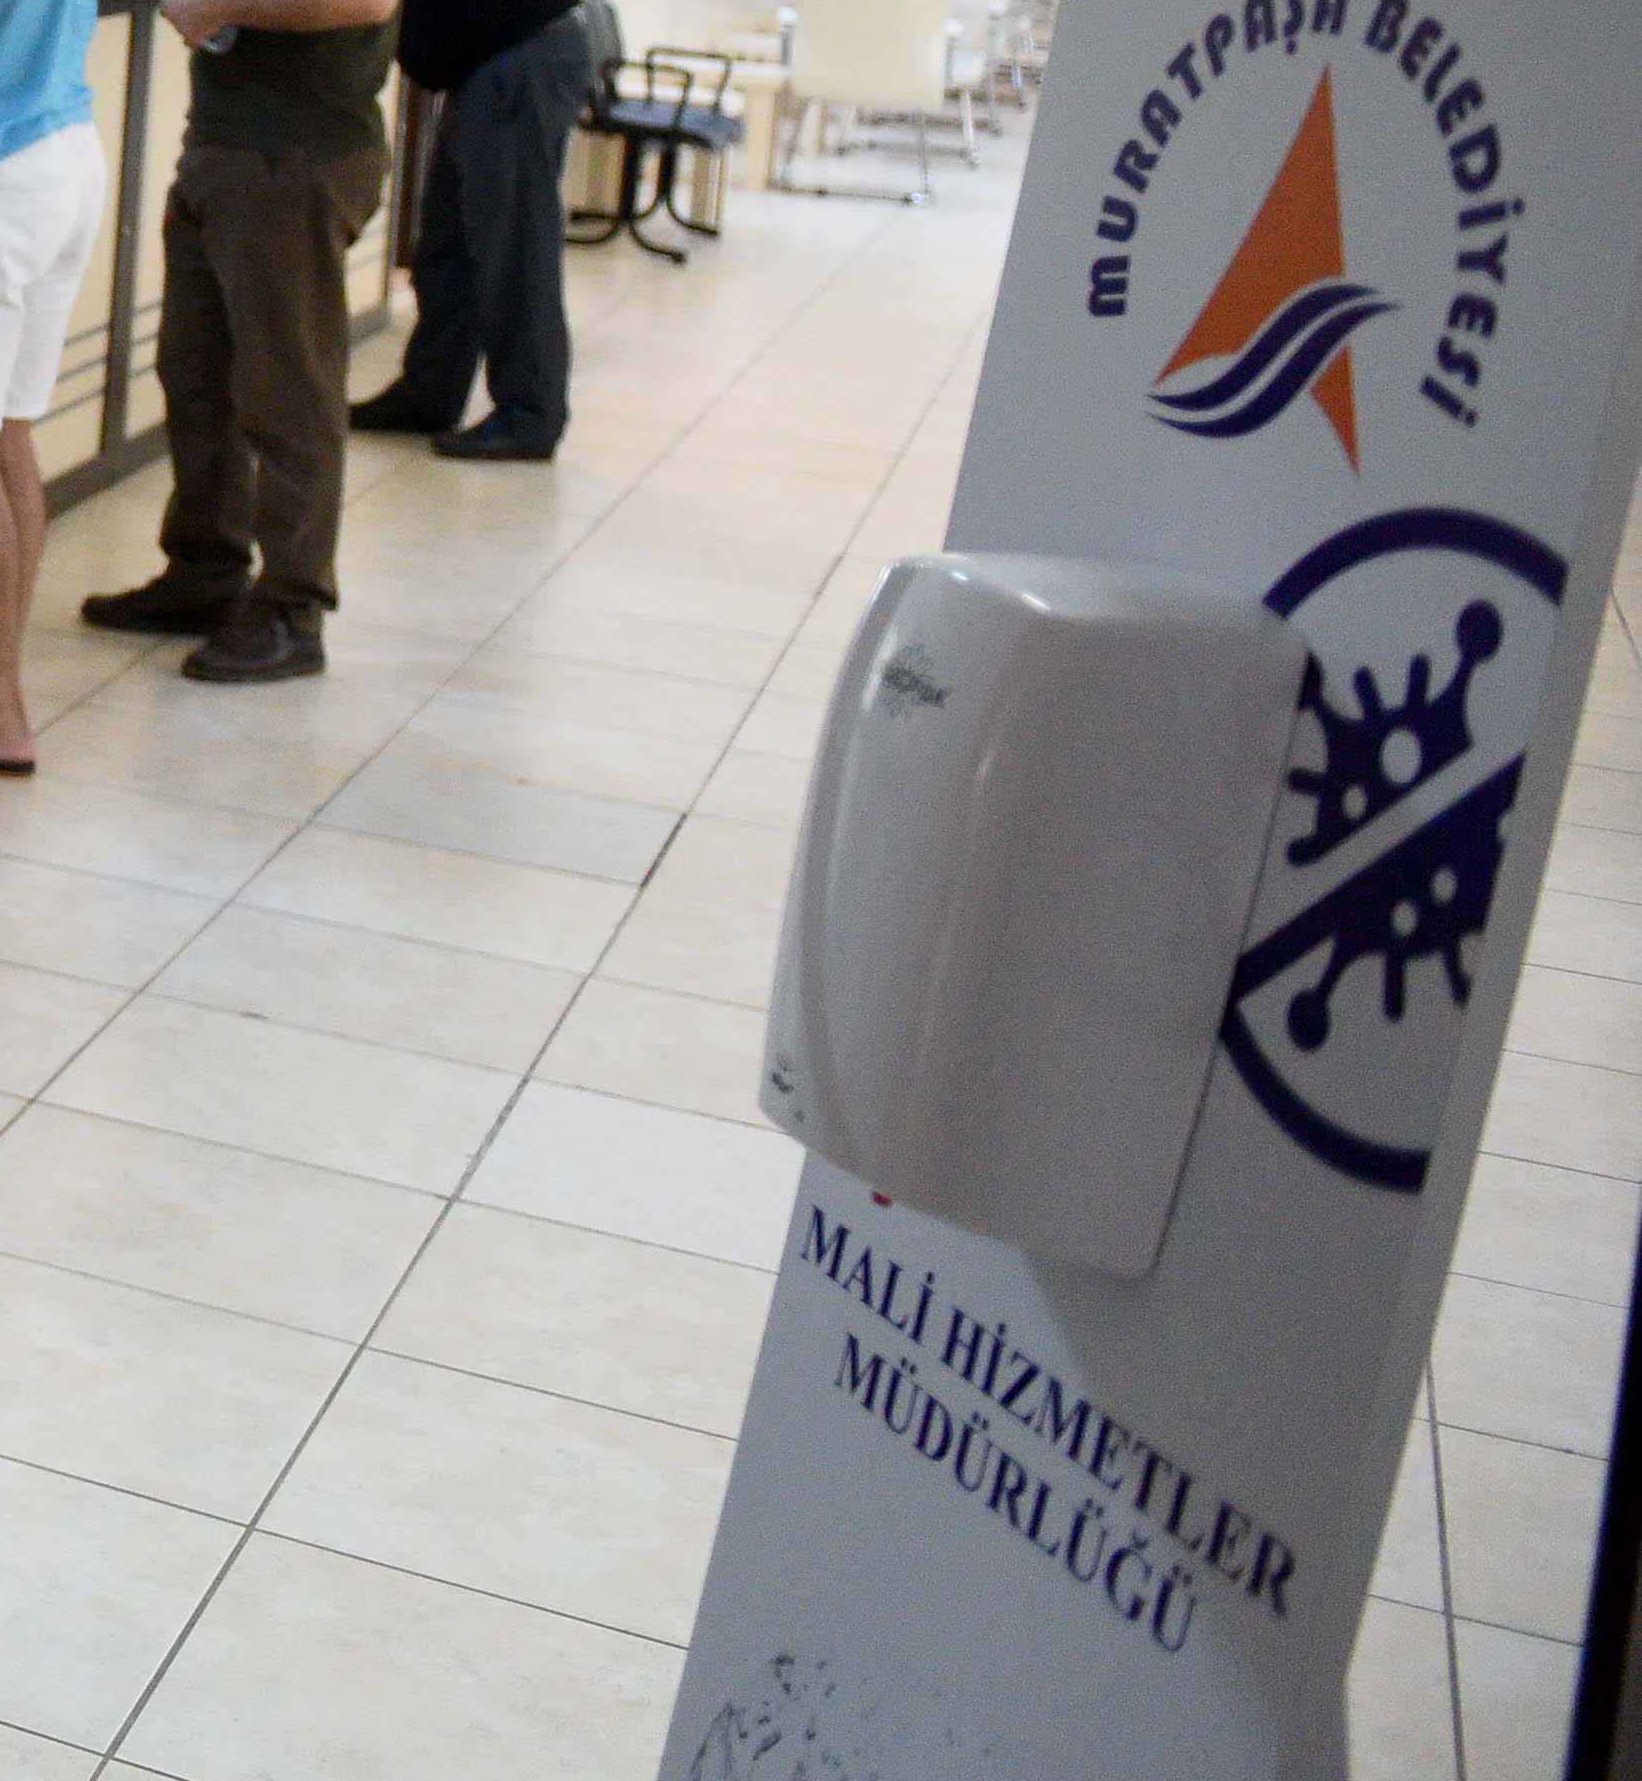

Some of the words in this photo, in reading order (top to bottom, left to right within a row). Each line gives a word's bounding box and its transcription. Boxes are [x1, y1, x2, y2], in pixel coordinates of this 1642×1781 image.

[800, 1204, 935, 1347] MALİ
[941, 1308, 1296, 1617] HİZMETLER
[834, 1331, 1198, 1653] MÜDÜRLÜĞÜ
